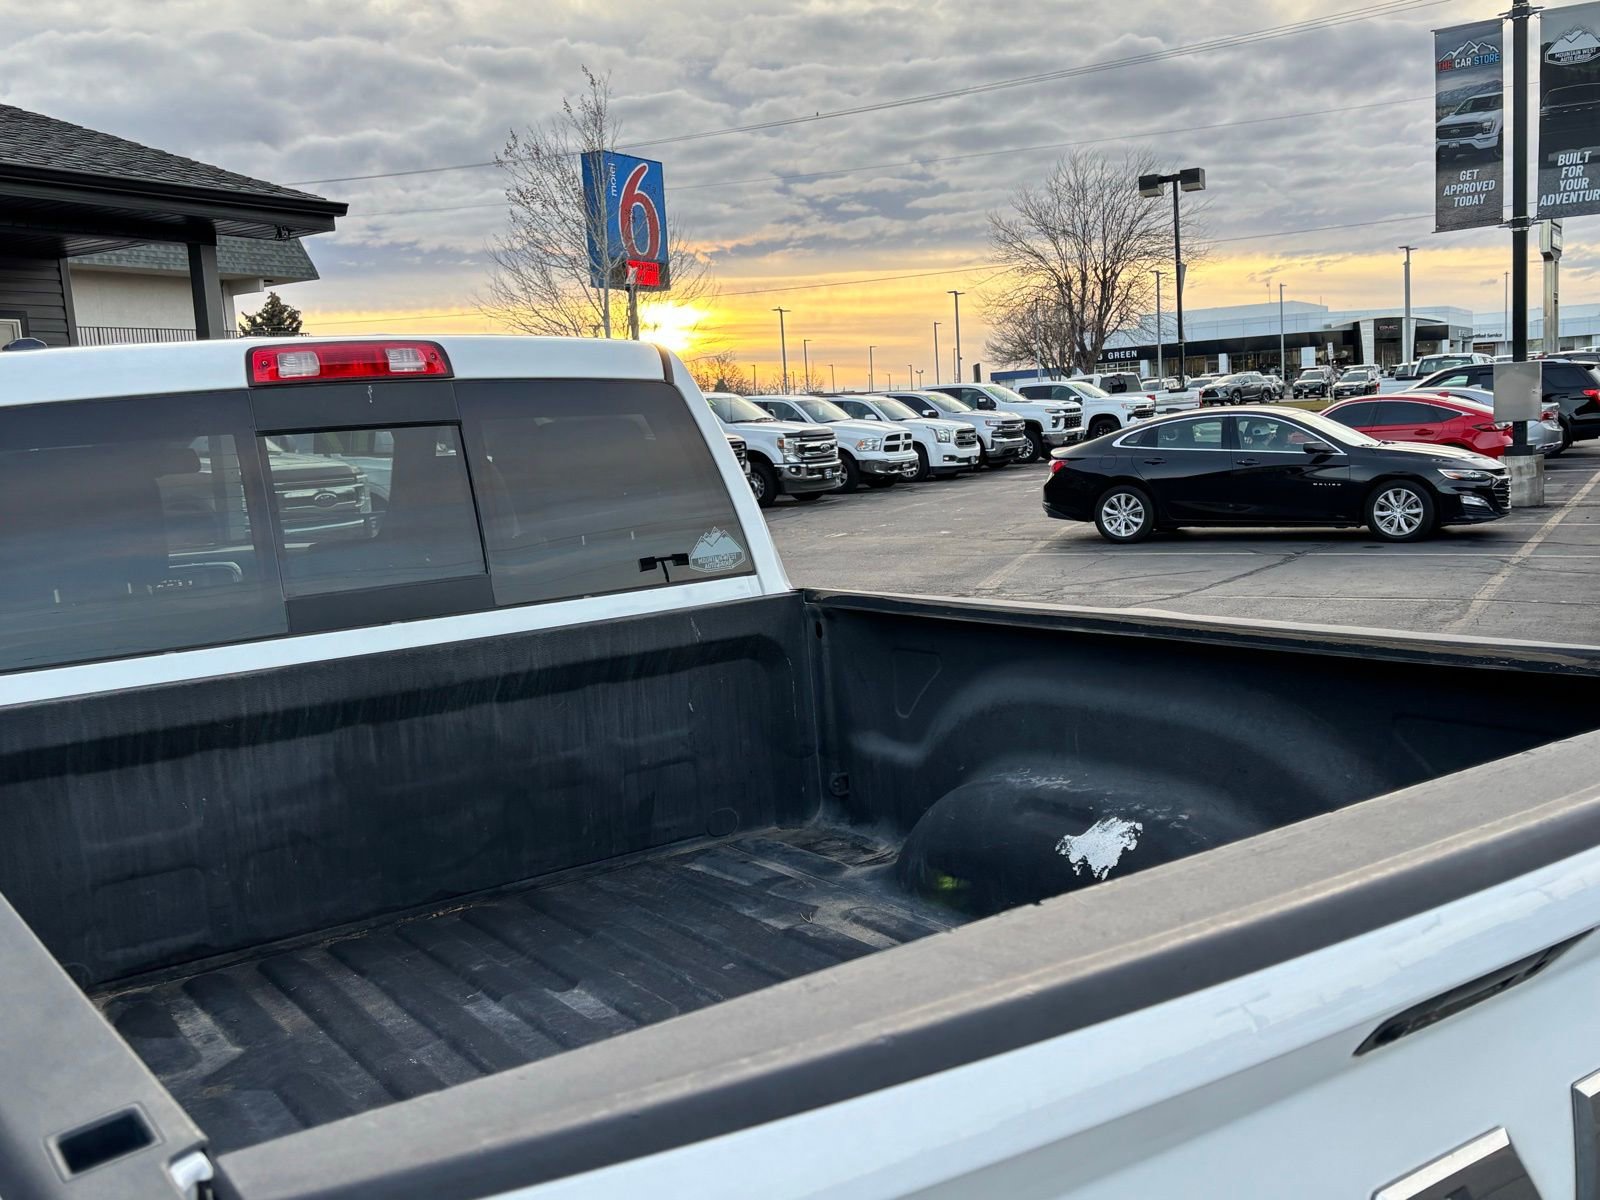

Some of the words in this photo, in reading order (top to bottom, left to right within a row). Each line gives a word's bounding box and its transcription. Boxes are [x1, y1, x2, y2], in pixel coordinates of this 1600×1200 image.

[1455, 57, 1472, 69] CAR
[1474, 52, 1500, 65] STORE
[1557, 151, 1592, 166] BUILT
[1459, 168, 1480, 181] GET
[1561, 165, 1584, 179] FOR
[1443, 179, 1496, 196] APPROVED
[1559, 177, 1589, 191] YOUR
[1453, 194, 1486, 207] TODAY
[619, 163, 660, 260] 6
[1107, 350, 1138, 360] GREEN
